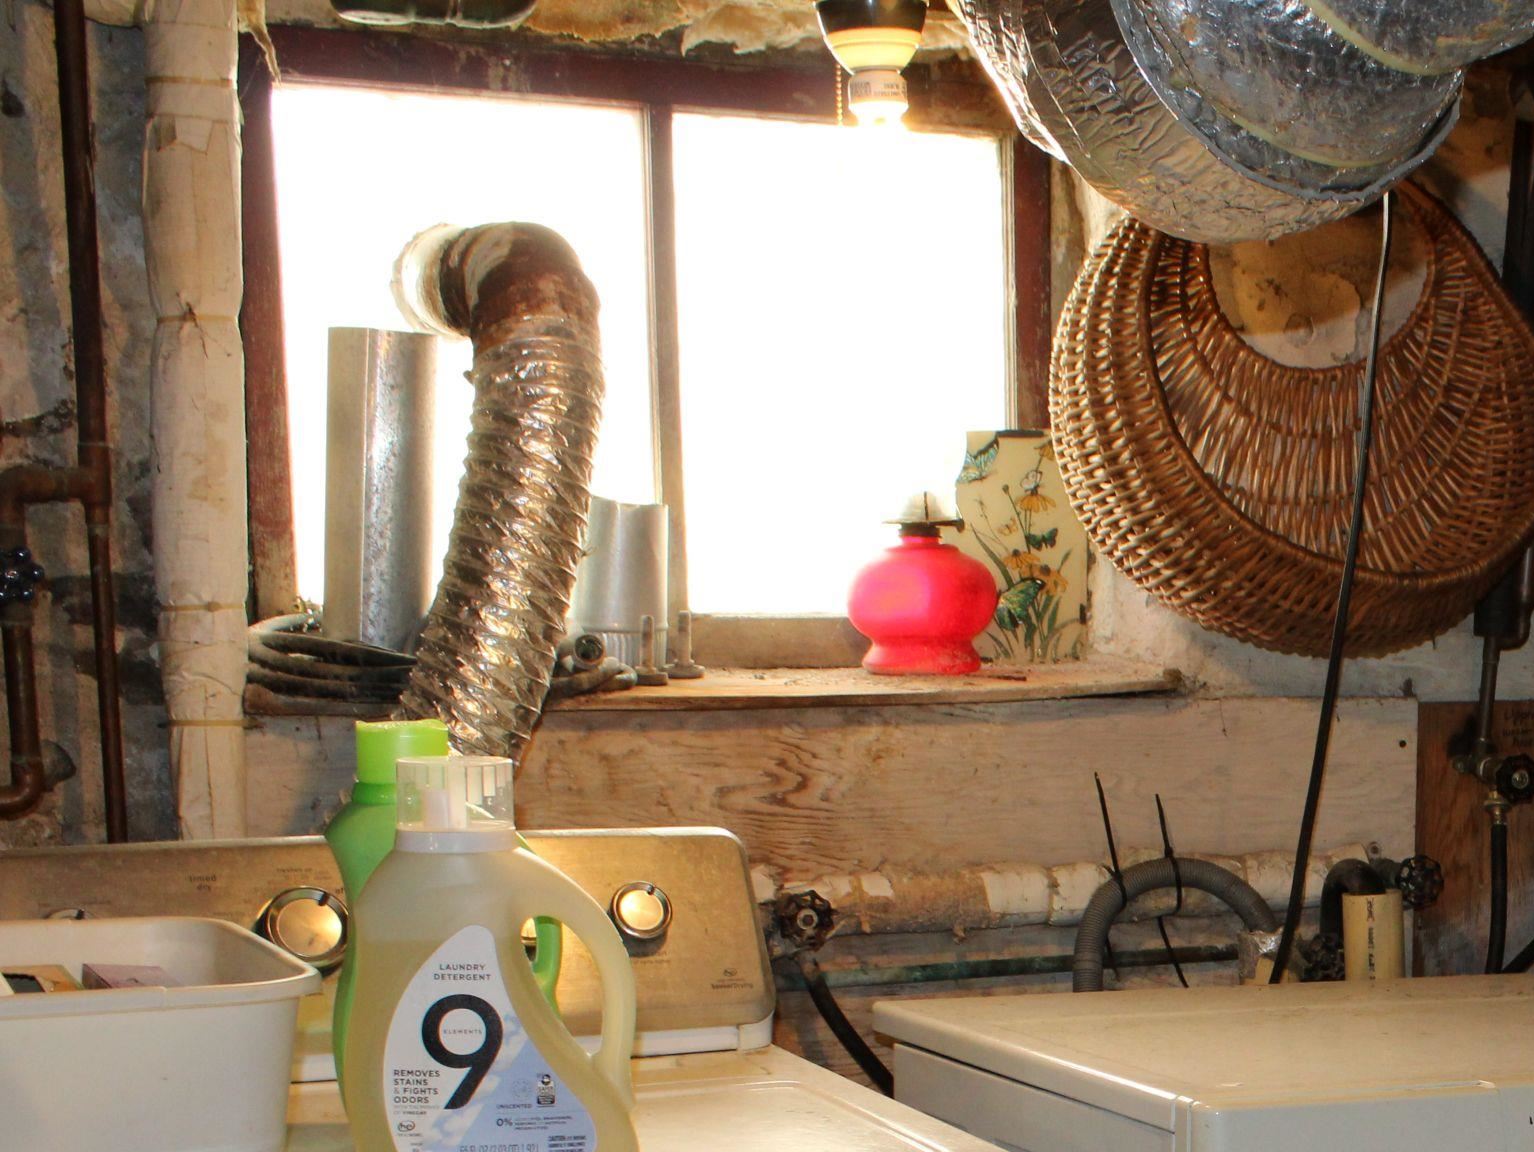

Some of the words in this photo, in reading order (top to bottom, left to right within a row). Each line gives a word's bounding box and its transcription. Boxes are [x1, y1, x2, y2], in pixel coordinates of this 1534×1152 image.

[439, 963, 486, 972] LAUNDRY
[433, 973, 492, 981] DETERGENT
[421, 993, 503, 1110] 9
[393, 1069, 441, 1078] REMOVES
[393, 1078, 429, 1087] STAINS
[393, 1087, 400, 1095] &
[403, 1087, 439, 1096] FIGHTS
[393, 1095, 430, 1104] ODORS
[496, 1118, 513, 1127] 0%
